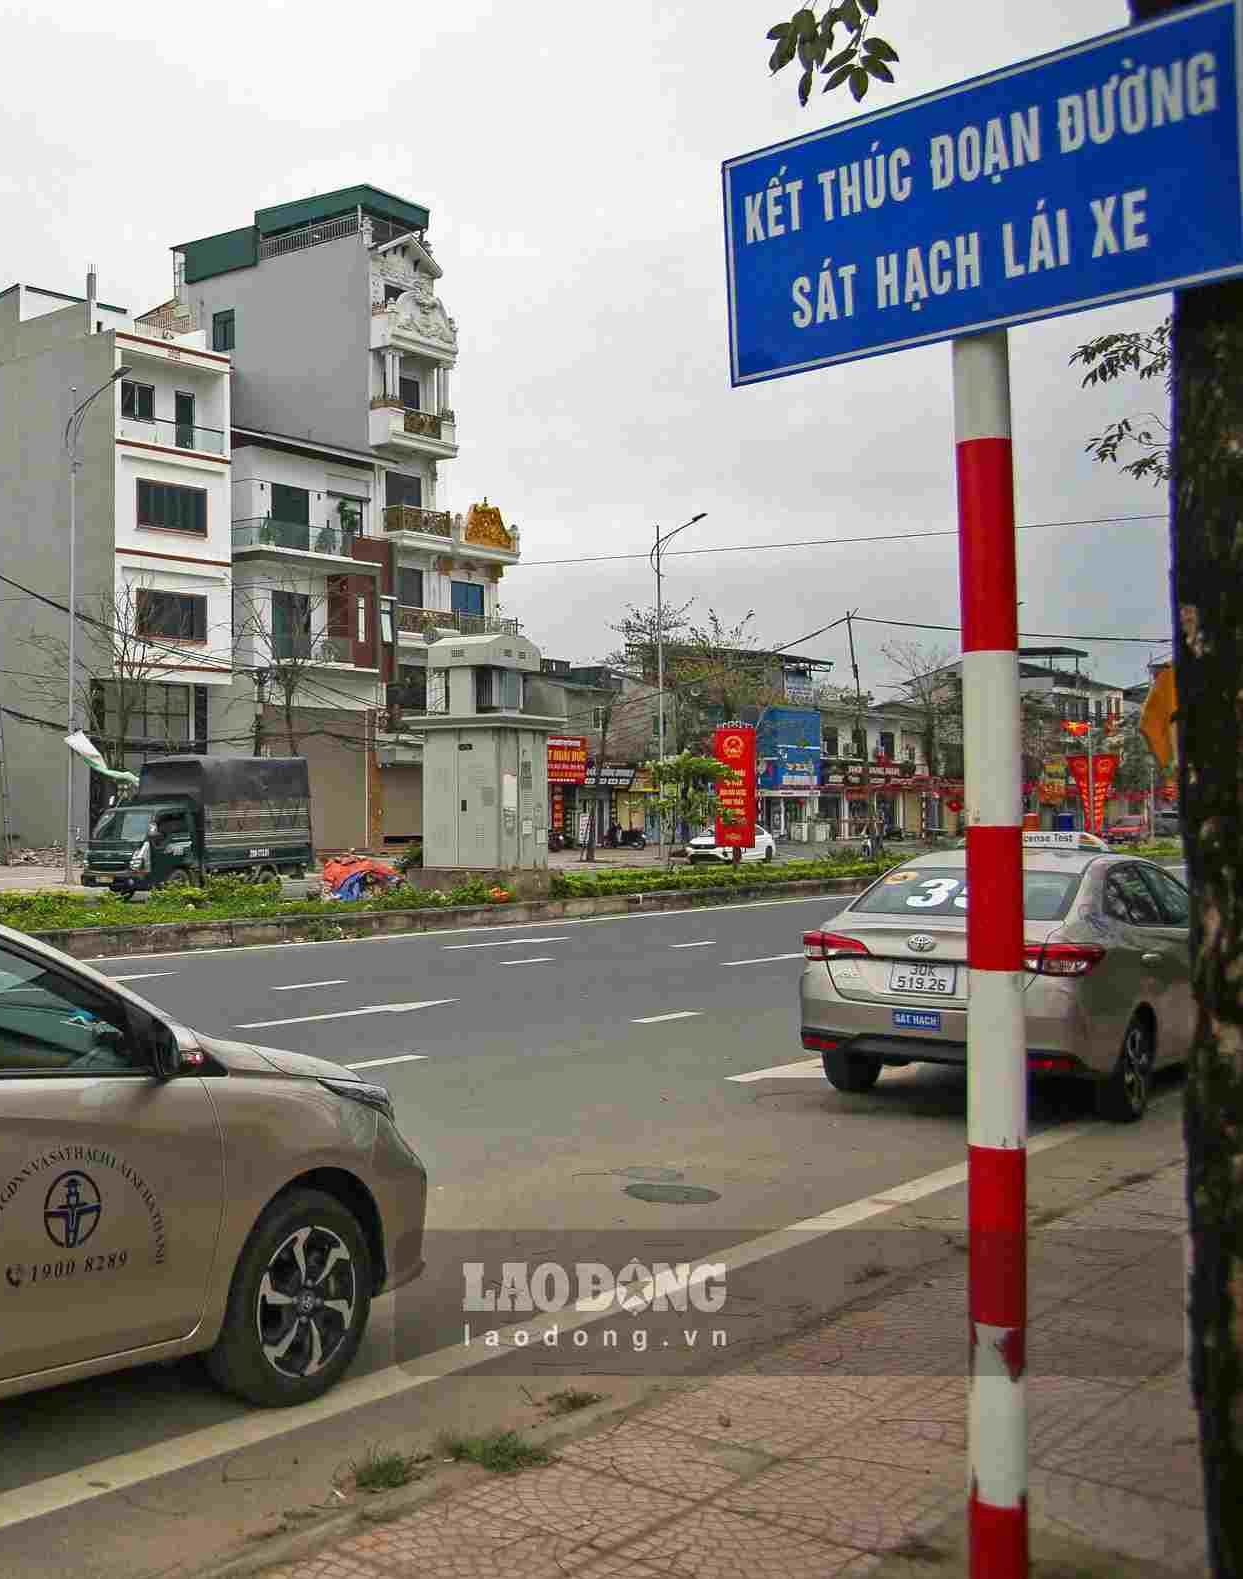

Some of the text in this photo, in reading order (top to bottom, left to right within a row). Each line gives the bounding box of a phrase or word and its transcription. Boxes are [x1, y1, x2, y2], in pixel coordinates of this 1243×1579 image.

[744, 51, 1219, 244] KẾT THÚC ĐOẠN ĐƯỜNG
[792, 189, 1148, 328] SÁT HẠCH LÁI XE
[29, 1251, 129, 1283] 1900 8289
